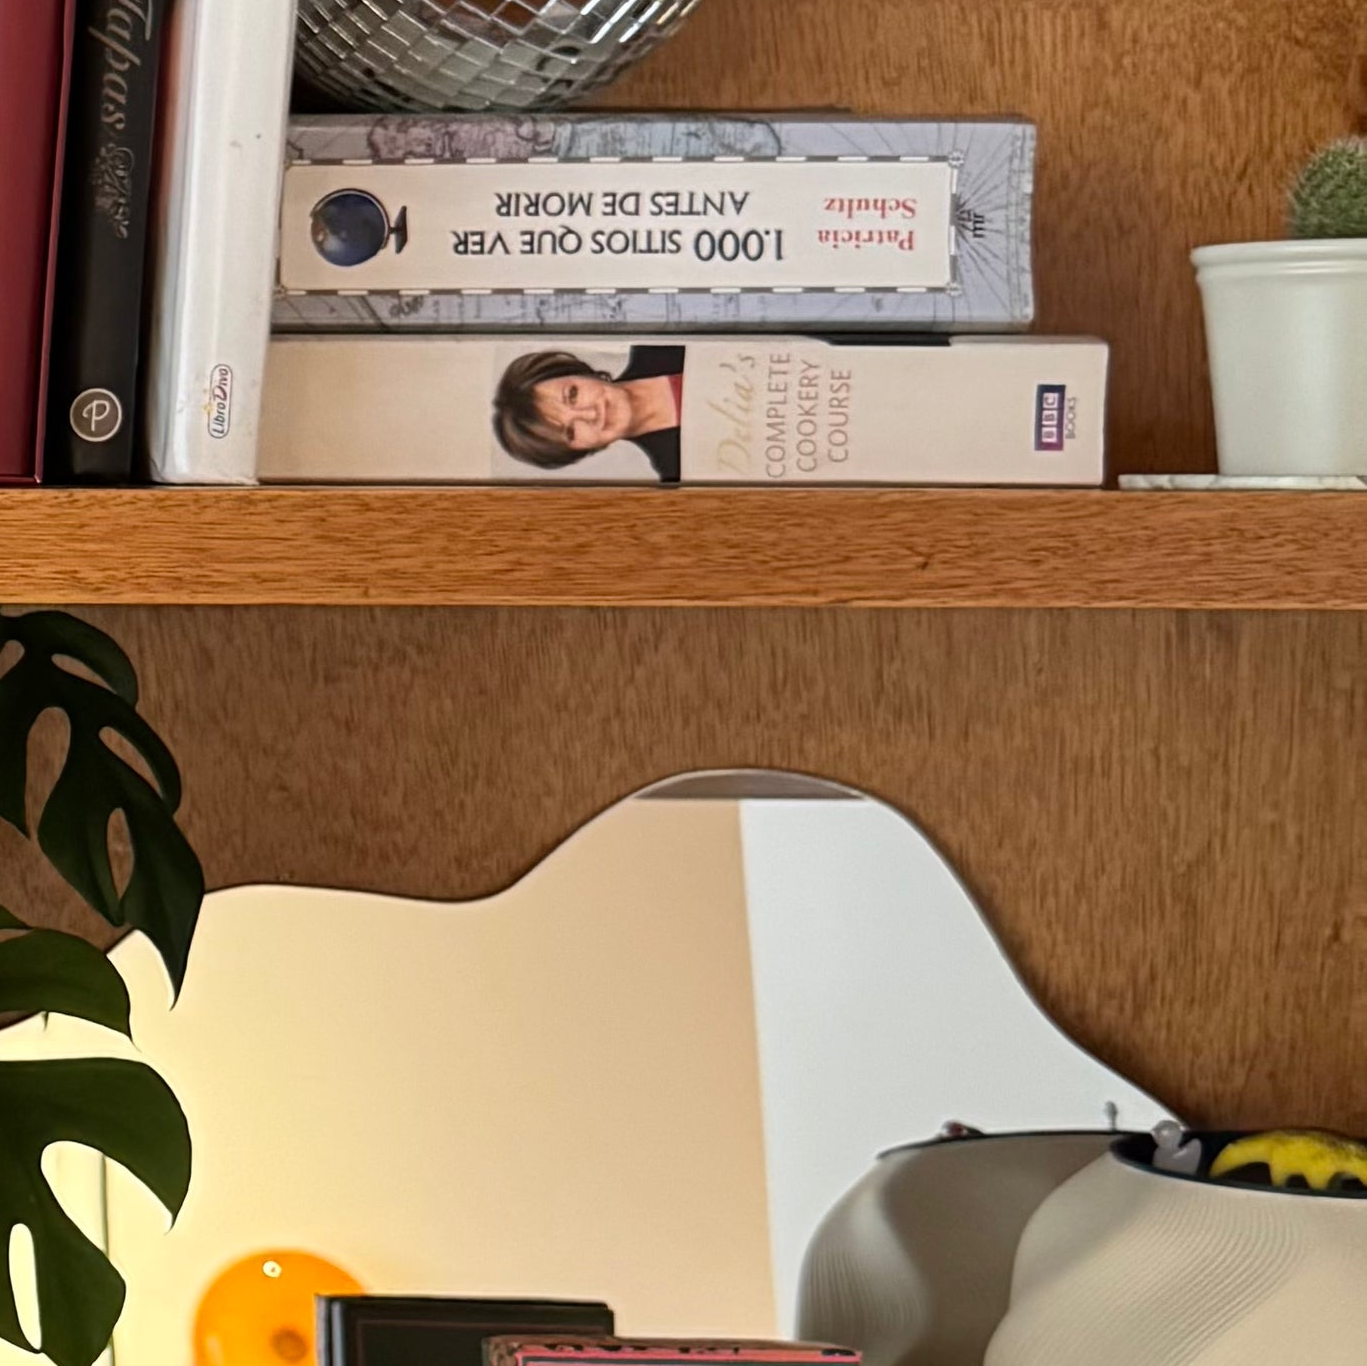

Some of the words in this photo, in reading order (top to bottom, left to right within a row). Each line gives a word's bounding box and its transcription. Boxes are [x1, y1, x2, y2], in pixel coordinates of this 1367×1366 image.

[495, 192, 591, 217] MORIR
[603, 192, 640, 216] DE
[650, 192, 750, 216] ANTES
[824, 196, 917, 219] Schultz
[452, 230, 510, 255] VER
[521, 226, 582, 255] QUE
[593, 230, 682, 254] SITIOS
[694, 230, 784, 261] 1.000
[818, 229, 915, 251] Patricia
[765, 352, 792, 478] COMPLETE
[797, 359, 821, 473] COOKERY
[827, 369, 853, 463] COURSE
[1041, 392, 1059, 444] BBC
[1065, 396, 1078, 439] BOOKS
